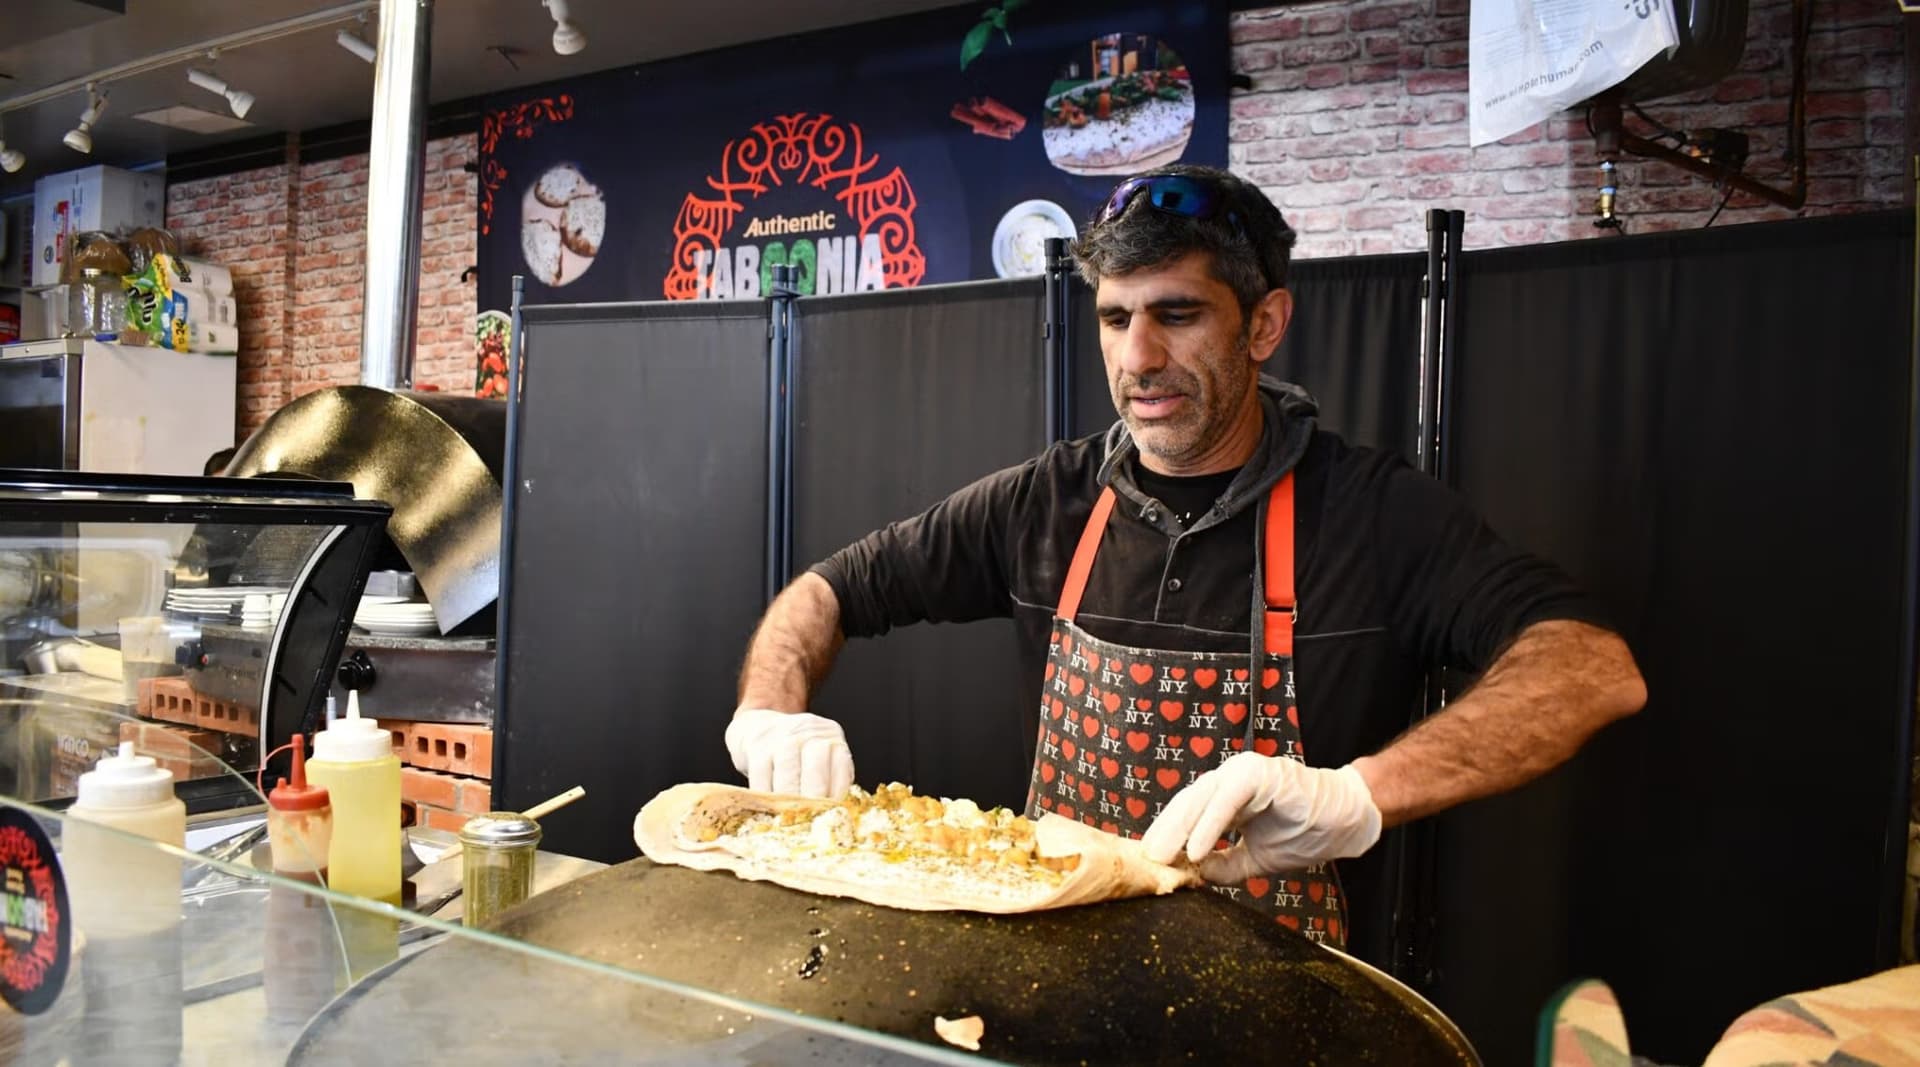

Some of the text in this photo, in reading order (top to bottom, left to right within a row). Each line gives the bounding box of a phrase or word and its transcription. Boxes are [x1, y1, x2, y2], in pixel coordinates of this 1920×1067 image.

[743, 210, 836, 238] Authentic
[693, 233, 885, 300] TABOONIA
[1070, 653, 1088, 672] NY
[1104, 657, 1111, 671] I
[1101, 670, 1124, 687] NY
[1162, 666, 1170, 680] I
[1225, 668, 1232, 681] I
[1053, 678, 1067, 696] NY
[1158, 679, 1188, 694] NY
[1222, 682, 1250, 695] NY
[1084, 695, 1101, 713] NY
[1128, 697, 1136, 710] I
[1192, 702, 1200, 714] I
[1257, 703, 1264, 716] I
[1125, 710, 1154, 726] NY
[1188, 716, 1218, 730] NY
[1254, 717, 1282, 732] NY
[1062, 718, 1079, 738] NY
[1100, 736, 1122, 754] NY
[1158, 734, 1166, 747] I
[1223, 738, 1230, 750] I
[1286, 740, 1294, 753] I
[1043, 741, 1058, 760] NY
[1154, 747, 1184, 762] NY
[1078, 760, 1097, 778] NY
[1126, 764, 1132, 777] I
[1057, 782, 1076, 800] NY
[1124, 776, 1150, 792] NY
[1099, 801, 1122, 818] NY
[1278, 880, 1286, 892] I
[1275, 893, 1303, 908] NY
[1307, 917, 1314, 930] I
